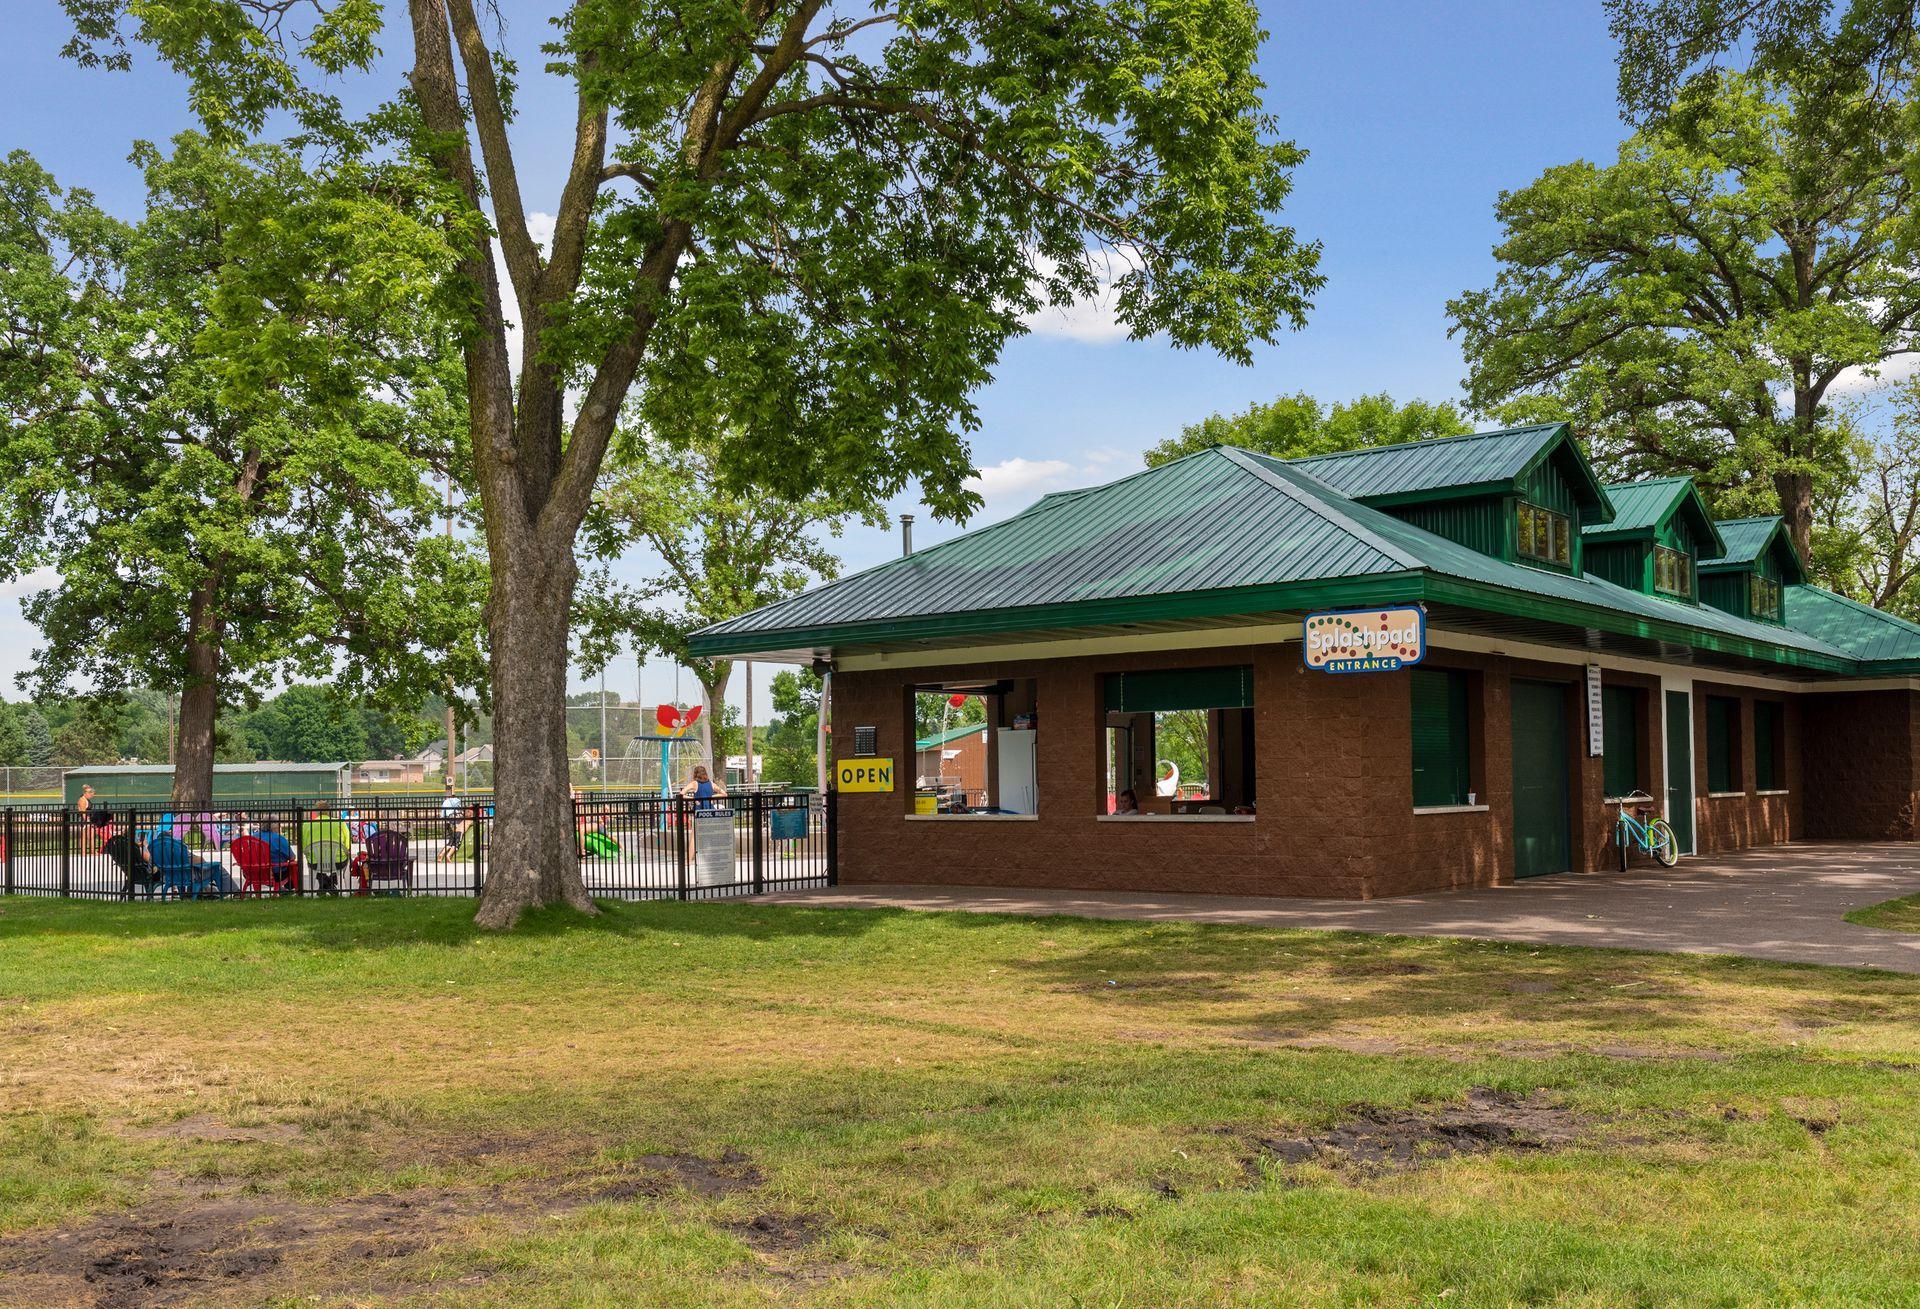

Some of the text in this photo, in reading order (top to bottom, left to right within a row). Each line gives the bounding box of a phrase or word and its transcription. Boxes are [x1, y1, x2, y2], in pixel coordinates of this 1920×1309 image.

[1309, 622, 1417, 654] Splashpad
[1329, 659, 1398, 671] ENTRANCE
[841, 767, 890, 784] OPEN
